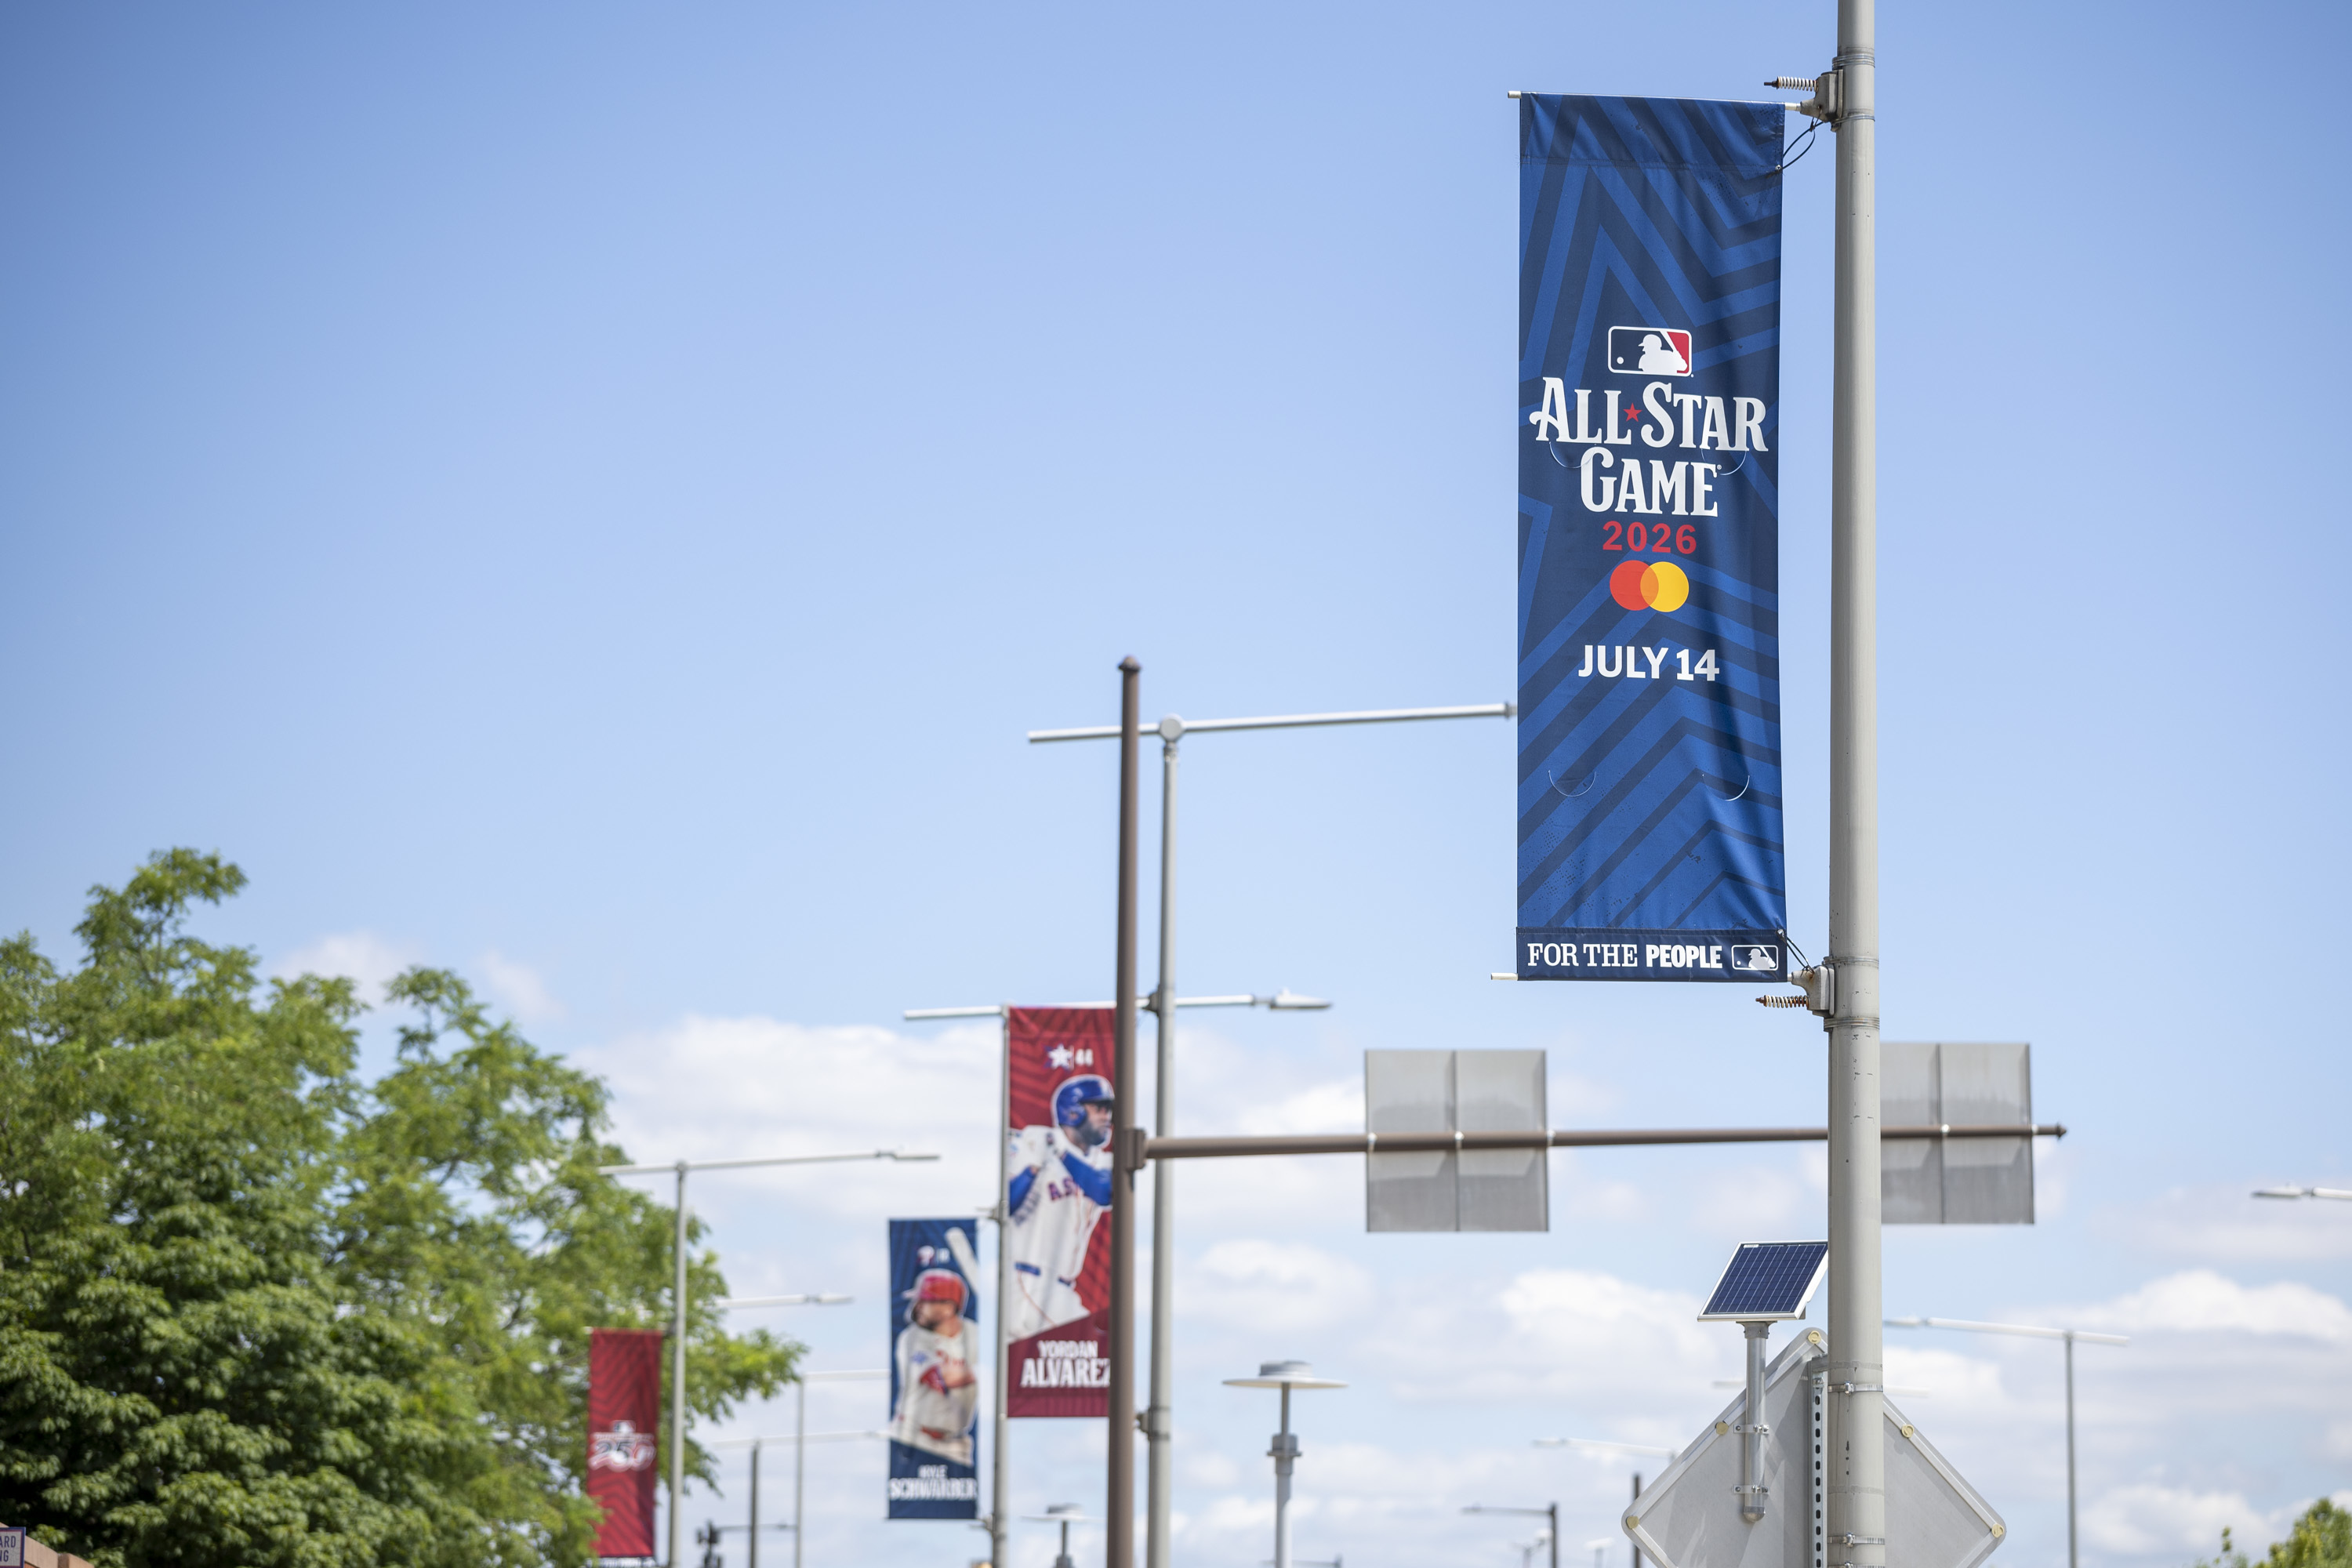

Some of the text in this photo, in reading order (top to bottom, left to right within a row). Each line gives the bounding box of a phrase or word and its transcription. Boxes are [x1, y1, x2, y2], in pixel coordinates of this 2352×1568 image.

[1529, 376, 1769, 452] ALL STAR
[1581, 446, 1718, 517] GAME
[1602, 521, 1697, 554] 2026
[1578, 644, 1720, 681] JULY 14
[1527, 943, 1722, 969] FOR THE PEOPLE
[1037, 1340, 1098, 1358] YORDAN
[1021, 1358, 1110, 1388] ALVAREZ
